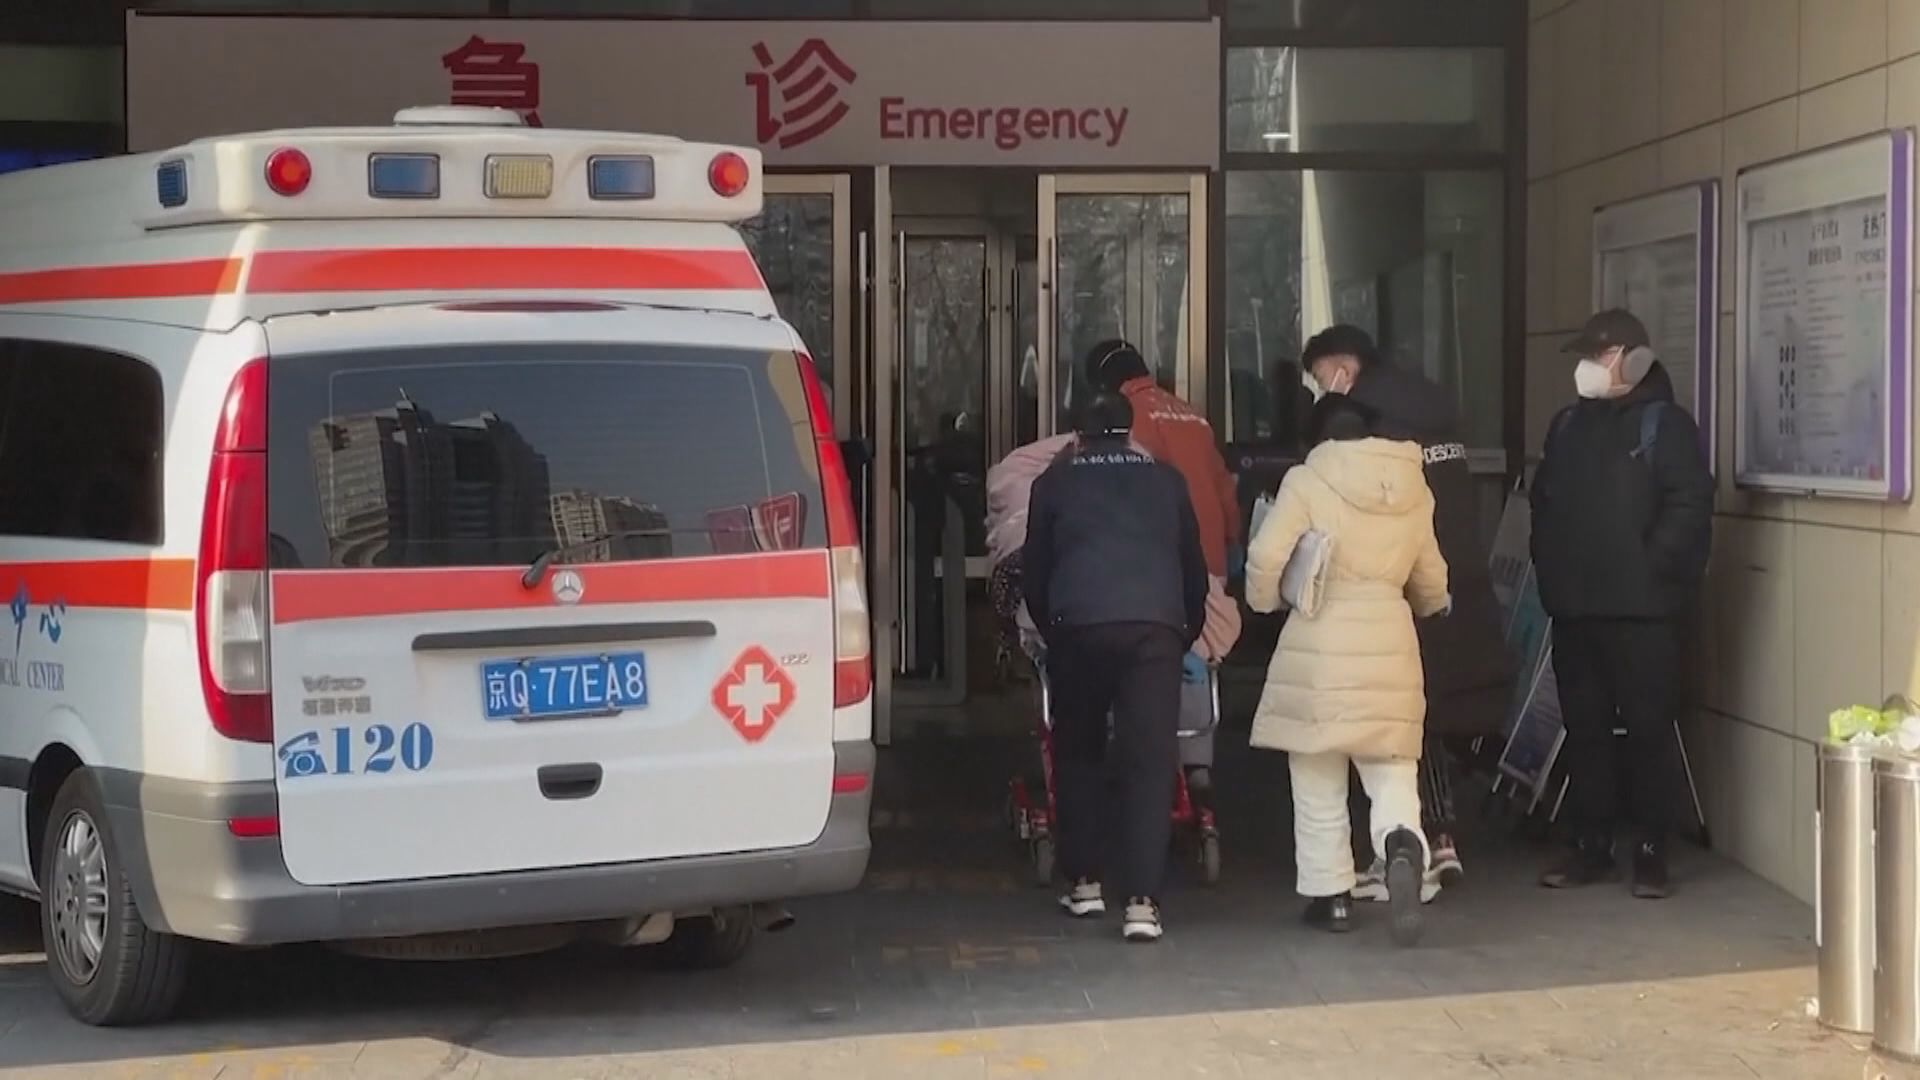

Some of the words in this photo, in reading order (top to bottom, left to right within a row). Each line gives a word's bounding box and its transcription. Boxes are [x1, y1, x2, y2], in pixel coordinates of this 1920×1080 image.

[879, 97, 1129, 150] Emergency
[26, 660, 65, 691] CENTER
[330, 721, 434, 776] 120
